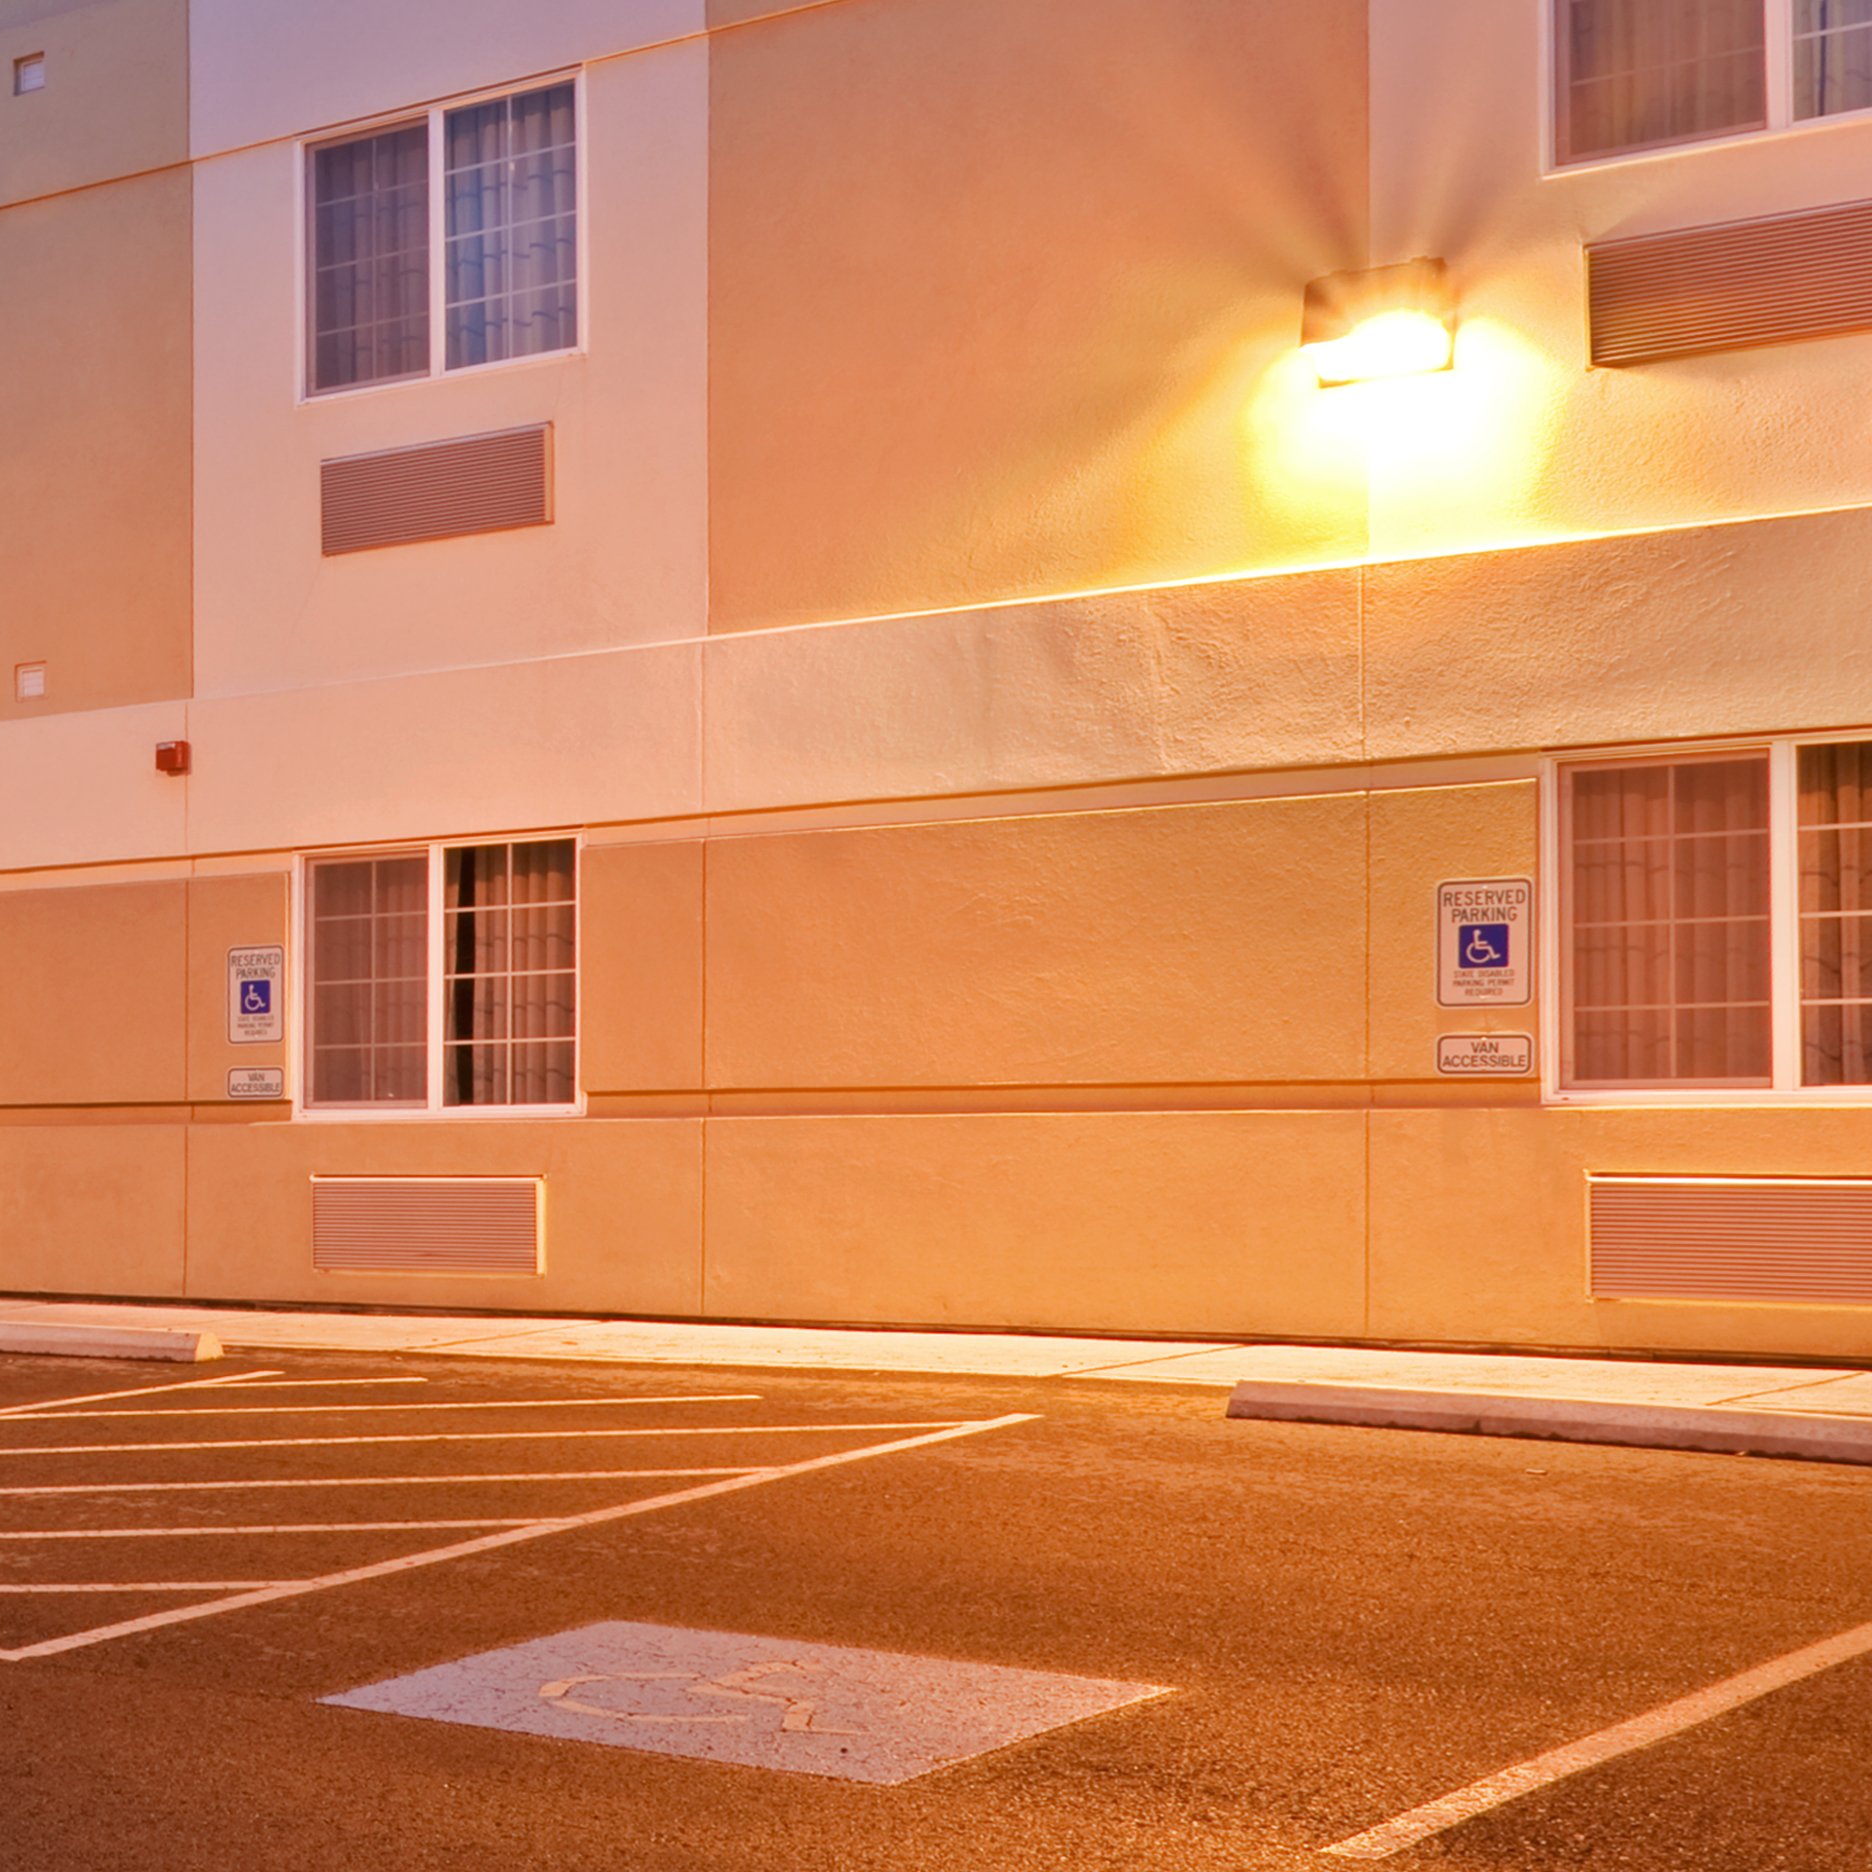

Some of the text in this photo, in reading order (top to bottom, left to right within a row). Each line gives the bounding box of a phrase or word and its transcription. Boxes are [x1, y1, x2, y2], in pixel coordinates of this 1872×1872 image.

[1442, 888, 1526, 907] RESERVED
[1451, 906, 1518, 923] PARKING
[230, 953, 281, 967] RESERVED
[235, 966, 276, 980] PARKING
[1470, 1042, 1499, 1054] VAN
[1442, 1054, 1526, 1068] ACCESSIBLE
[247, 1072, 265, 1082] VAN
[231, 1082, 281, 1093] ACCESSIBLE
